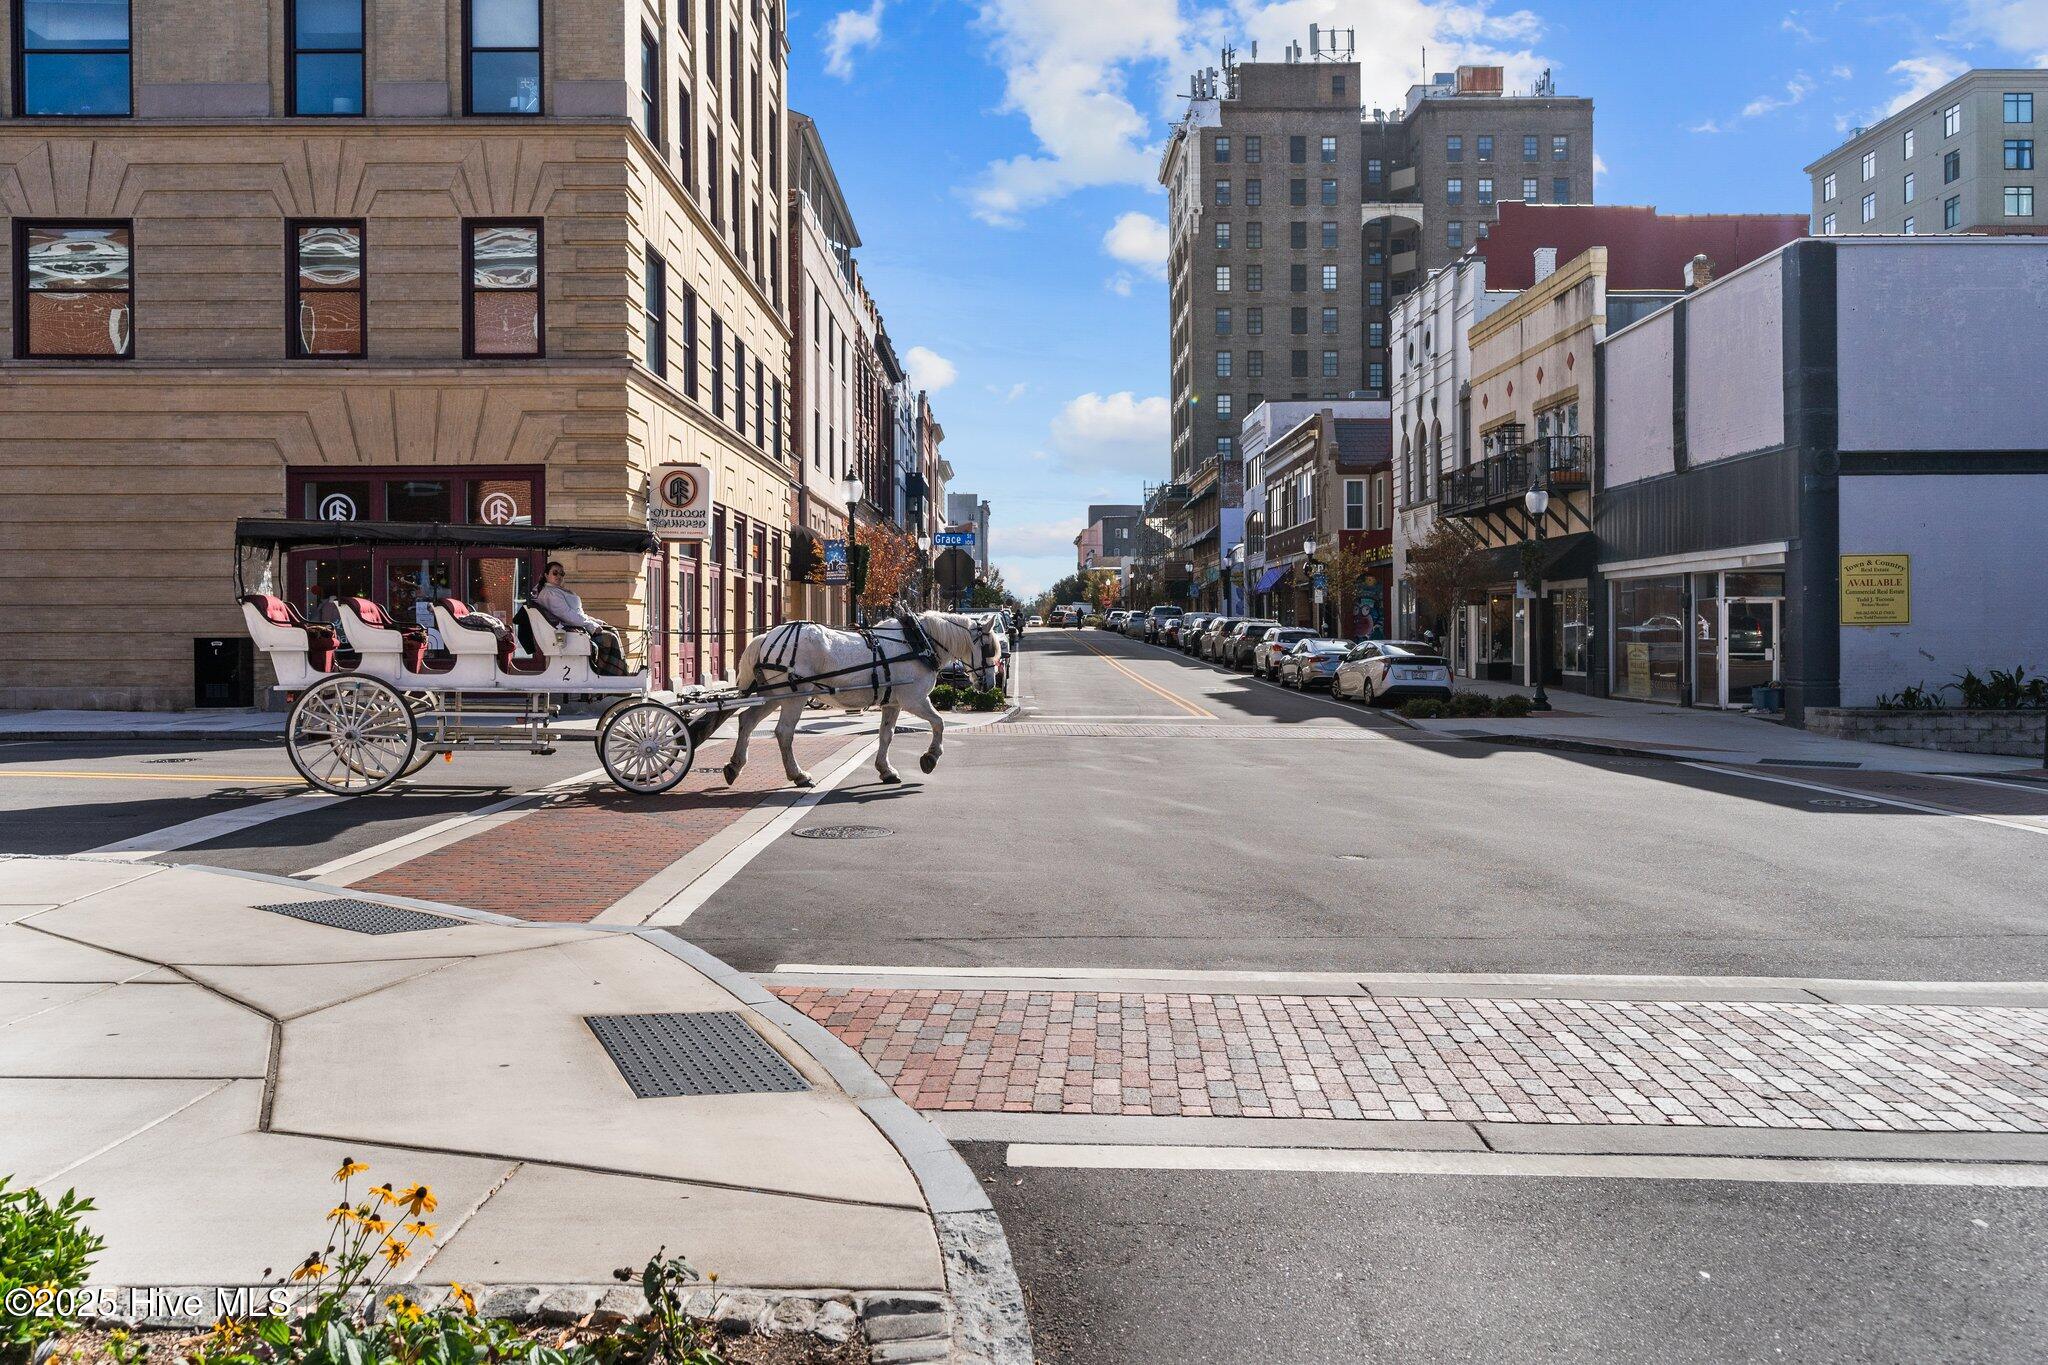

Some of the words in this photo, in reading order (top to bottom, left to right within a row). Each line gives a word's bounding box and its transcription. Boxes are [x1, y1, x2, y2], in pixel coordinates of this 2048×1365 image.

[651, 508, 706, 518] OUTDOOR
[651, 518, 706, 528] EQUIPPED
[935, 534, 961, 543] Grace
[1844, 561, 1865, 572] Town
[1875, 559, 1906, 572] Country
[1847, 578, 1903, 586] AVAILABLE
[562, 665, 571, 681] 2
